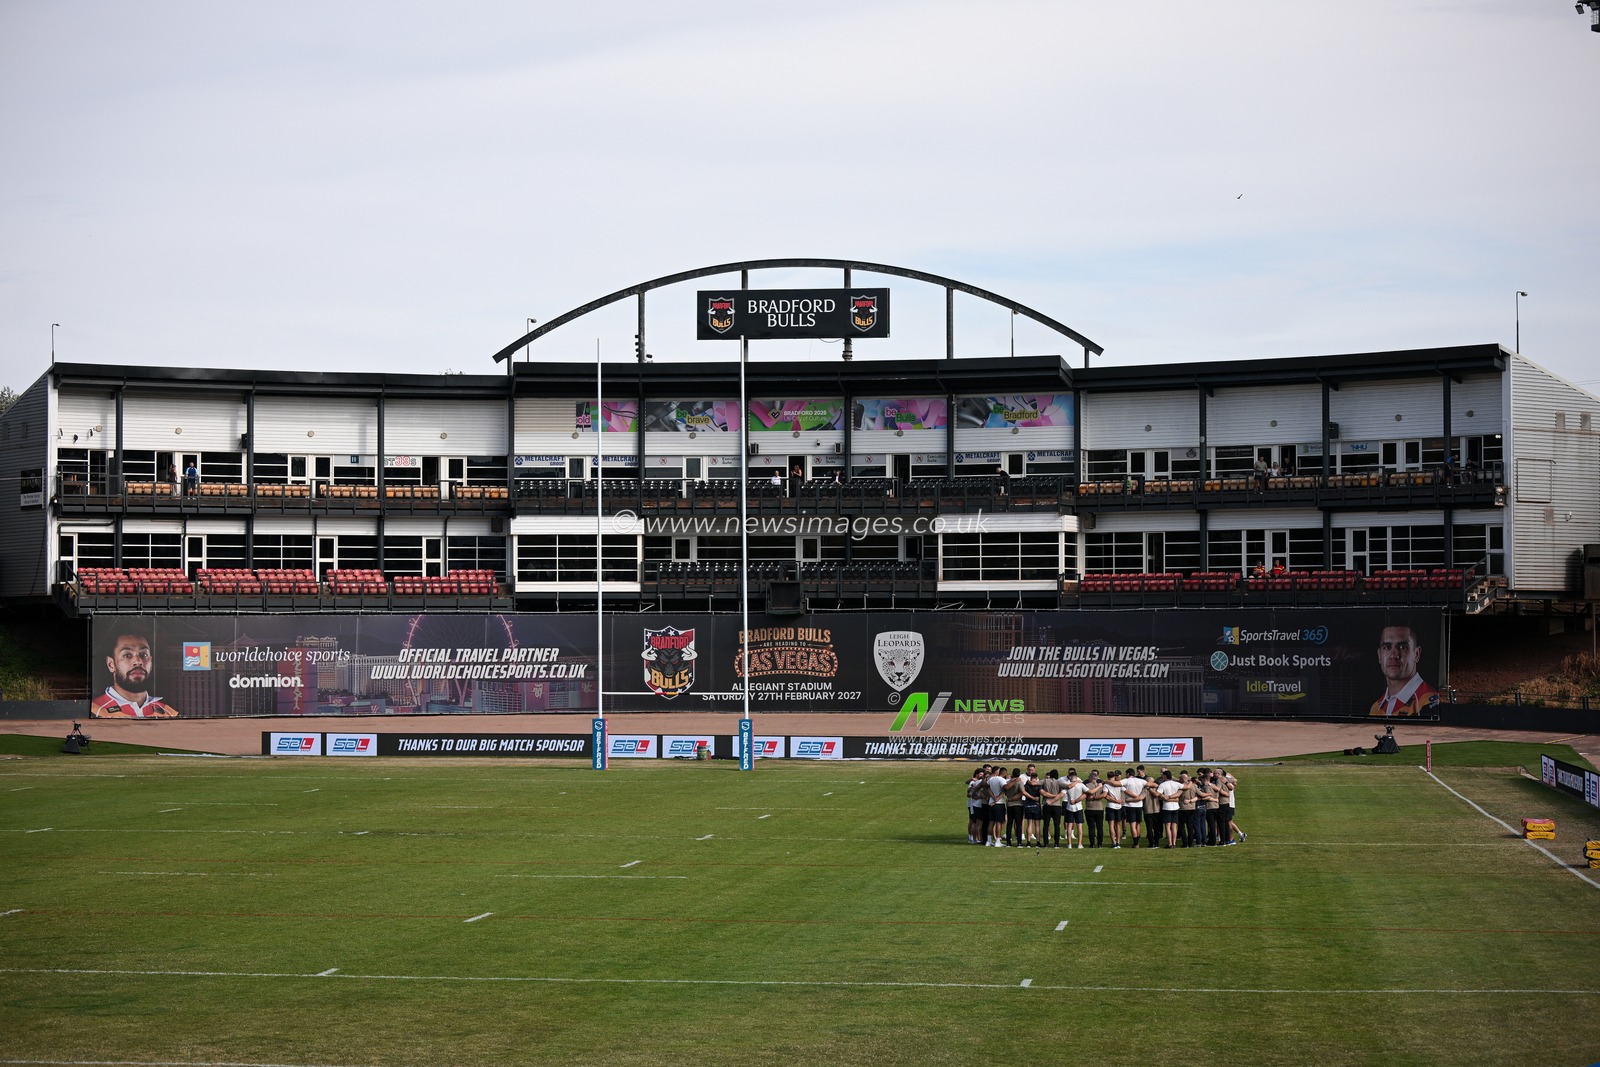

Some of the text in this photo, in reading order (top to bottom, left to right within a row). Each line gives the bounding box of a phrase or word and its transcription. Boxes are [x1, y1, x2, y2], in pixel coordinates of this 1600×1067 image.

[748, 300, 836, 314] BRADFORD
[712, 317, 731, 328] BULLS
[768, 314, 816, 327] BULLS
[854, 316, 873, 326] BULLS
[886, 408, 896, 416] be
[1004, 410, 1038, 419] Bradford
[688, 416, 710, 424] brave
[738, 627, 832, 644] BRADFORD BULLS
[1240, 628, 1324, 644] SportsTravel 365
[650, 636, 689, 650] BRADFORD
[877, 639, 921, 648] LEOPARDS
[215, 646, 350, 664] worldchoice sports
[398, 648, 560, 662] OFFICIAL TRAVEL PARTNER
[1006, 646, 1160, 661] JOIN THE BULLS IN VEGAS:
[741, 650, 832, 672] LAS VEGAS
[1229, 654, 1331, 669] Just Book Sports
[370, 664, 588, 680] WWW.WORLDCHOICESPORTS.CO.UK
[998, 663, 1170, 678] WWW.BULLSGOTOVEGAS.COM
[229, 674, 304, 688] dominion.
[650, 668, 689, 689] BULLS
[732, 682, 832, 691] ALEGIANT STADIUM
[1246, 680, 1302, 692] IdleTravel
[758, 692, 783, 700] 27TH
[784, 692, 836, 700] FEBRUARY
[838, 692, 862, 700] 2027
[398, 738, 584, 752] THANKS TO OUR BIG MATCH SPONSOR
[864, 742, 907, 755] THANKS
[909, 742, 921, 755] TO
[922, 742, 946, 755] OUR
[949, 742, 967, 755] BIG
[970, 743, 1005, 756] MATCH
[1007, 744, 1058, 756] SPONSOR
